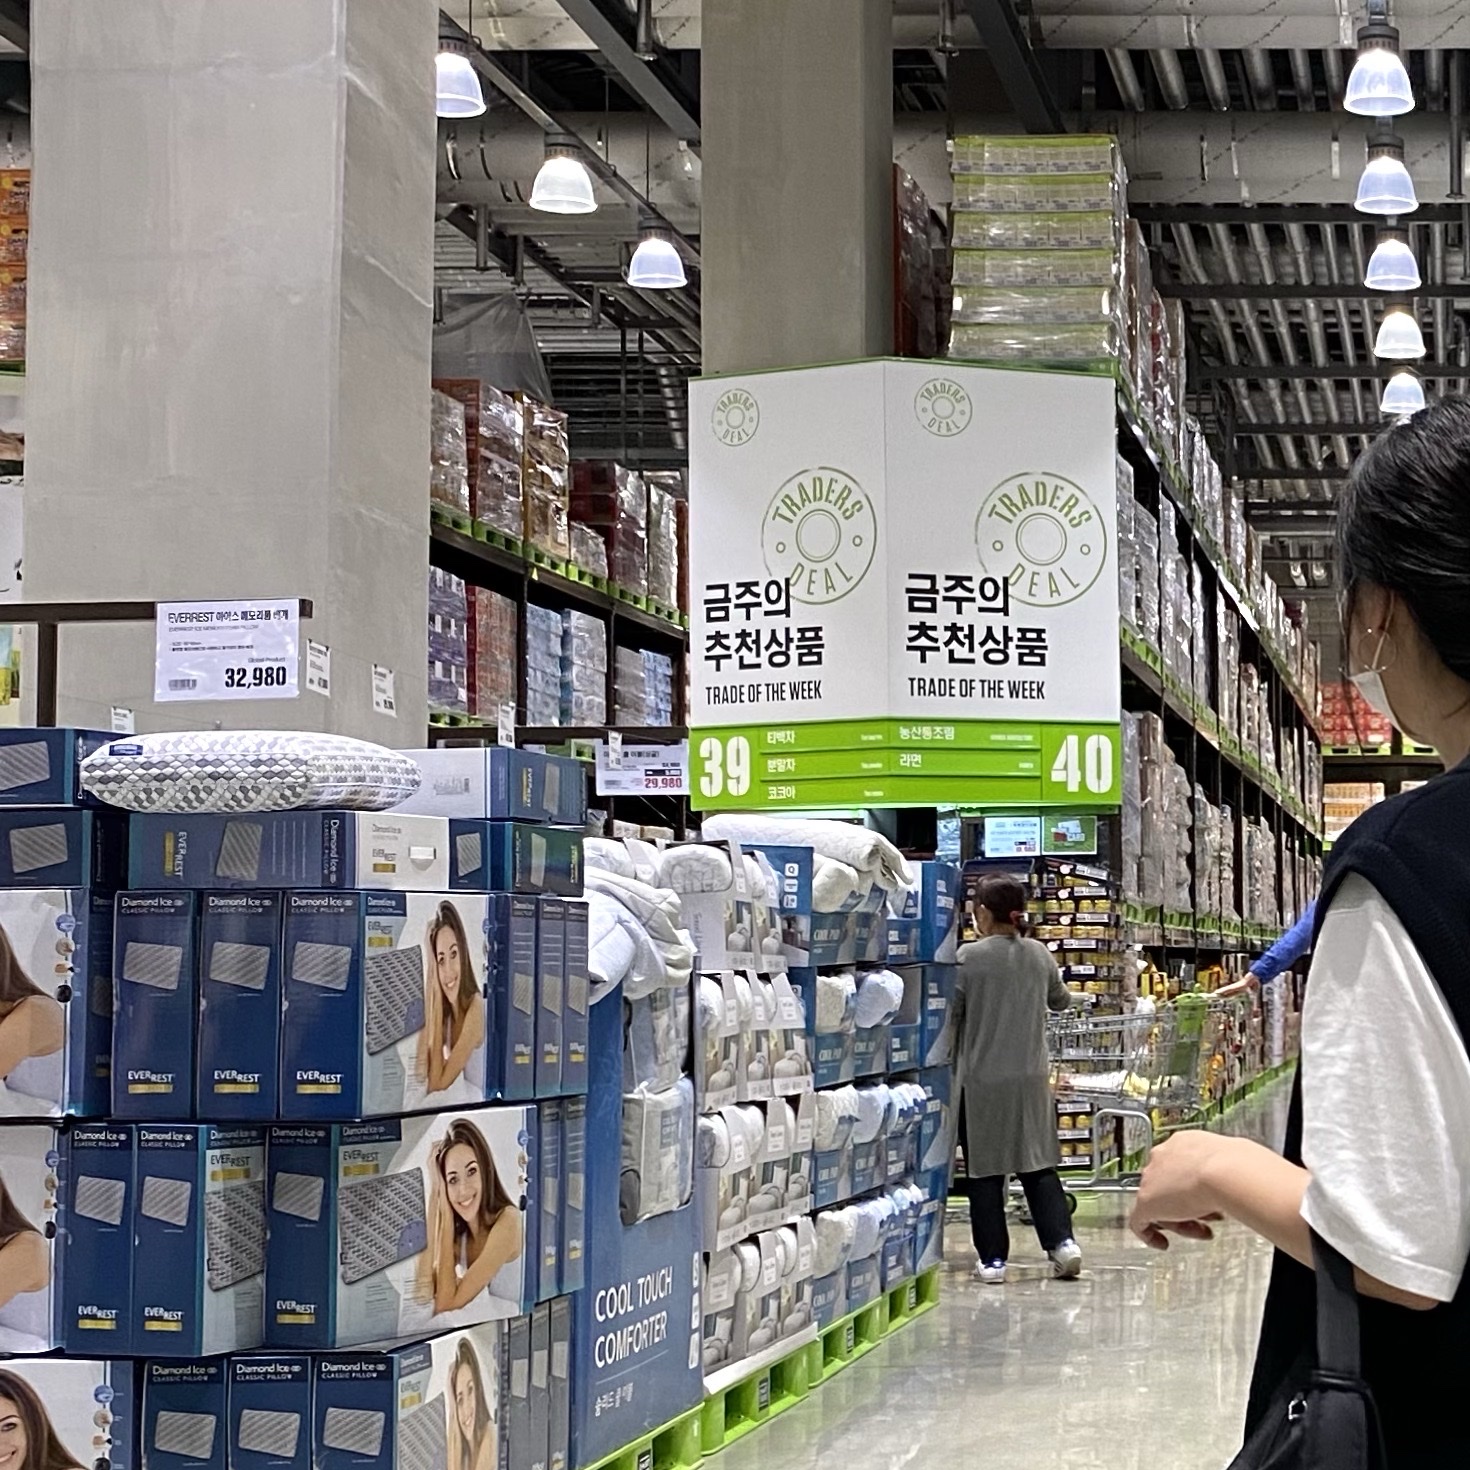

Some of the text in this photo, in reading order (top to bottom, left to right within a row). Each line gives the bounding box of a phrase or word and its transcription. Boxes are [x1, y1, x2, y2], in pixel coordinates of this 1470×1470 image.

[716, 393, 754, 413] TRADERS
[919, 382, 966, 404] TRADERS
[927, 417, 961, 432] DEAL
[722, 428, 751, 444] DEAL
[772, 476, 864, 521] TRADERS
[988, 481, 1093, 529] TRADERS
[789, 561, 853, 595] DEAL
[1008, 562, 1080, 598] DEAL
[703, 576, 791, 624] 금주의
[905, 573, 1010, 617] 금주의
[168, 612, 215, 624] EVERREST
[703, 625, 825, 672] 추천상품
[905, 622, 1049, 668] 추천상품
[225, 666, 287, 689] 32,980
[908, 677, 1045, 700] TRADE OF THE WEEK
[705, 680, 822, 706] TRADE OF THE WEEK
[767, 730, 795, 745] 티백차
[899, 726, 955, 740] 농산통조림
[700, 736, 751, 798] 39
[767, 758, 796, 773] 분말차
[899, 753, 922, 768] 라면
[1051, 734, 1113, 794] 40
[767, 786, 795, 800] 코코아
[121, 897, 173, 907] Diamond Ice
[208, 897, 261, 907] Diamond Ice
[127, 1070, 173, 1083] EVERREST
[213, 1070, 260, 1083] EVERREST
[296, 1070, 341, 1084] EVERREST
[595, 1266, 673, 1323] COOL TOUCH
[594, 1310, 668, 1369] COMFORTER
[152, 1365, 206, 1374] Diamond Ice
